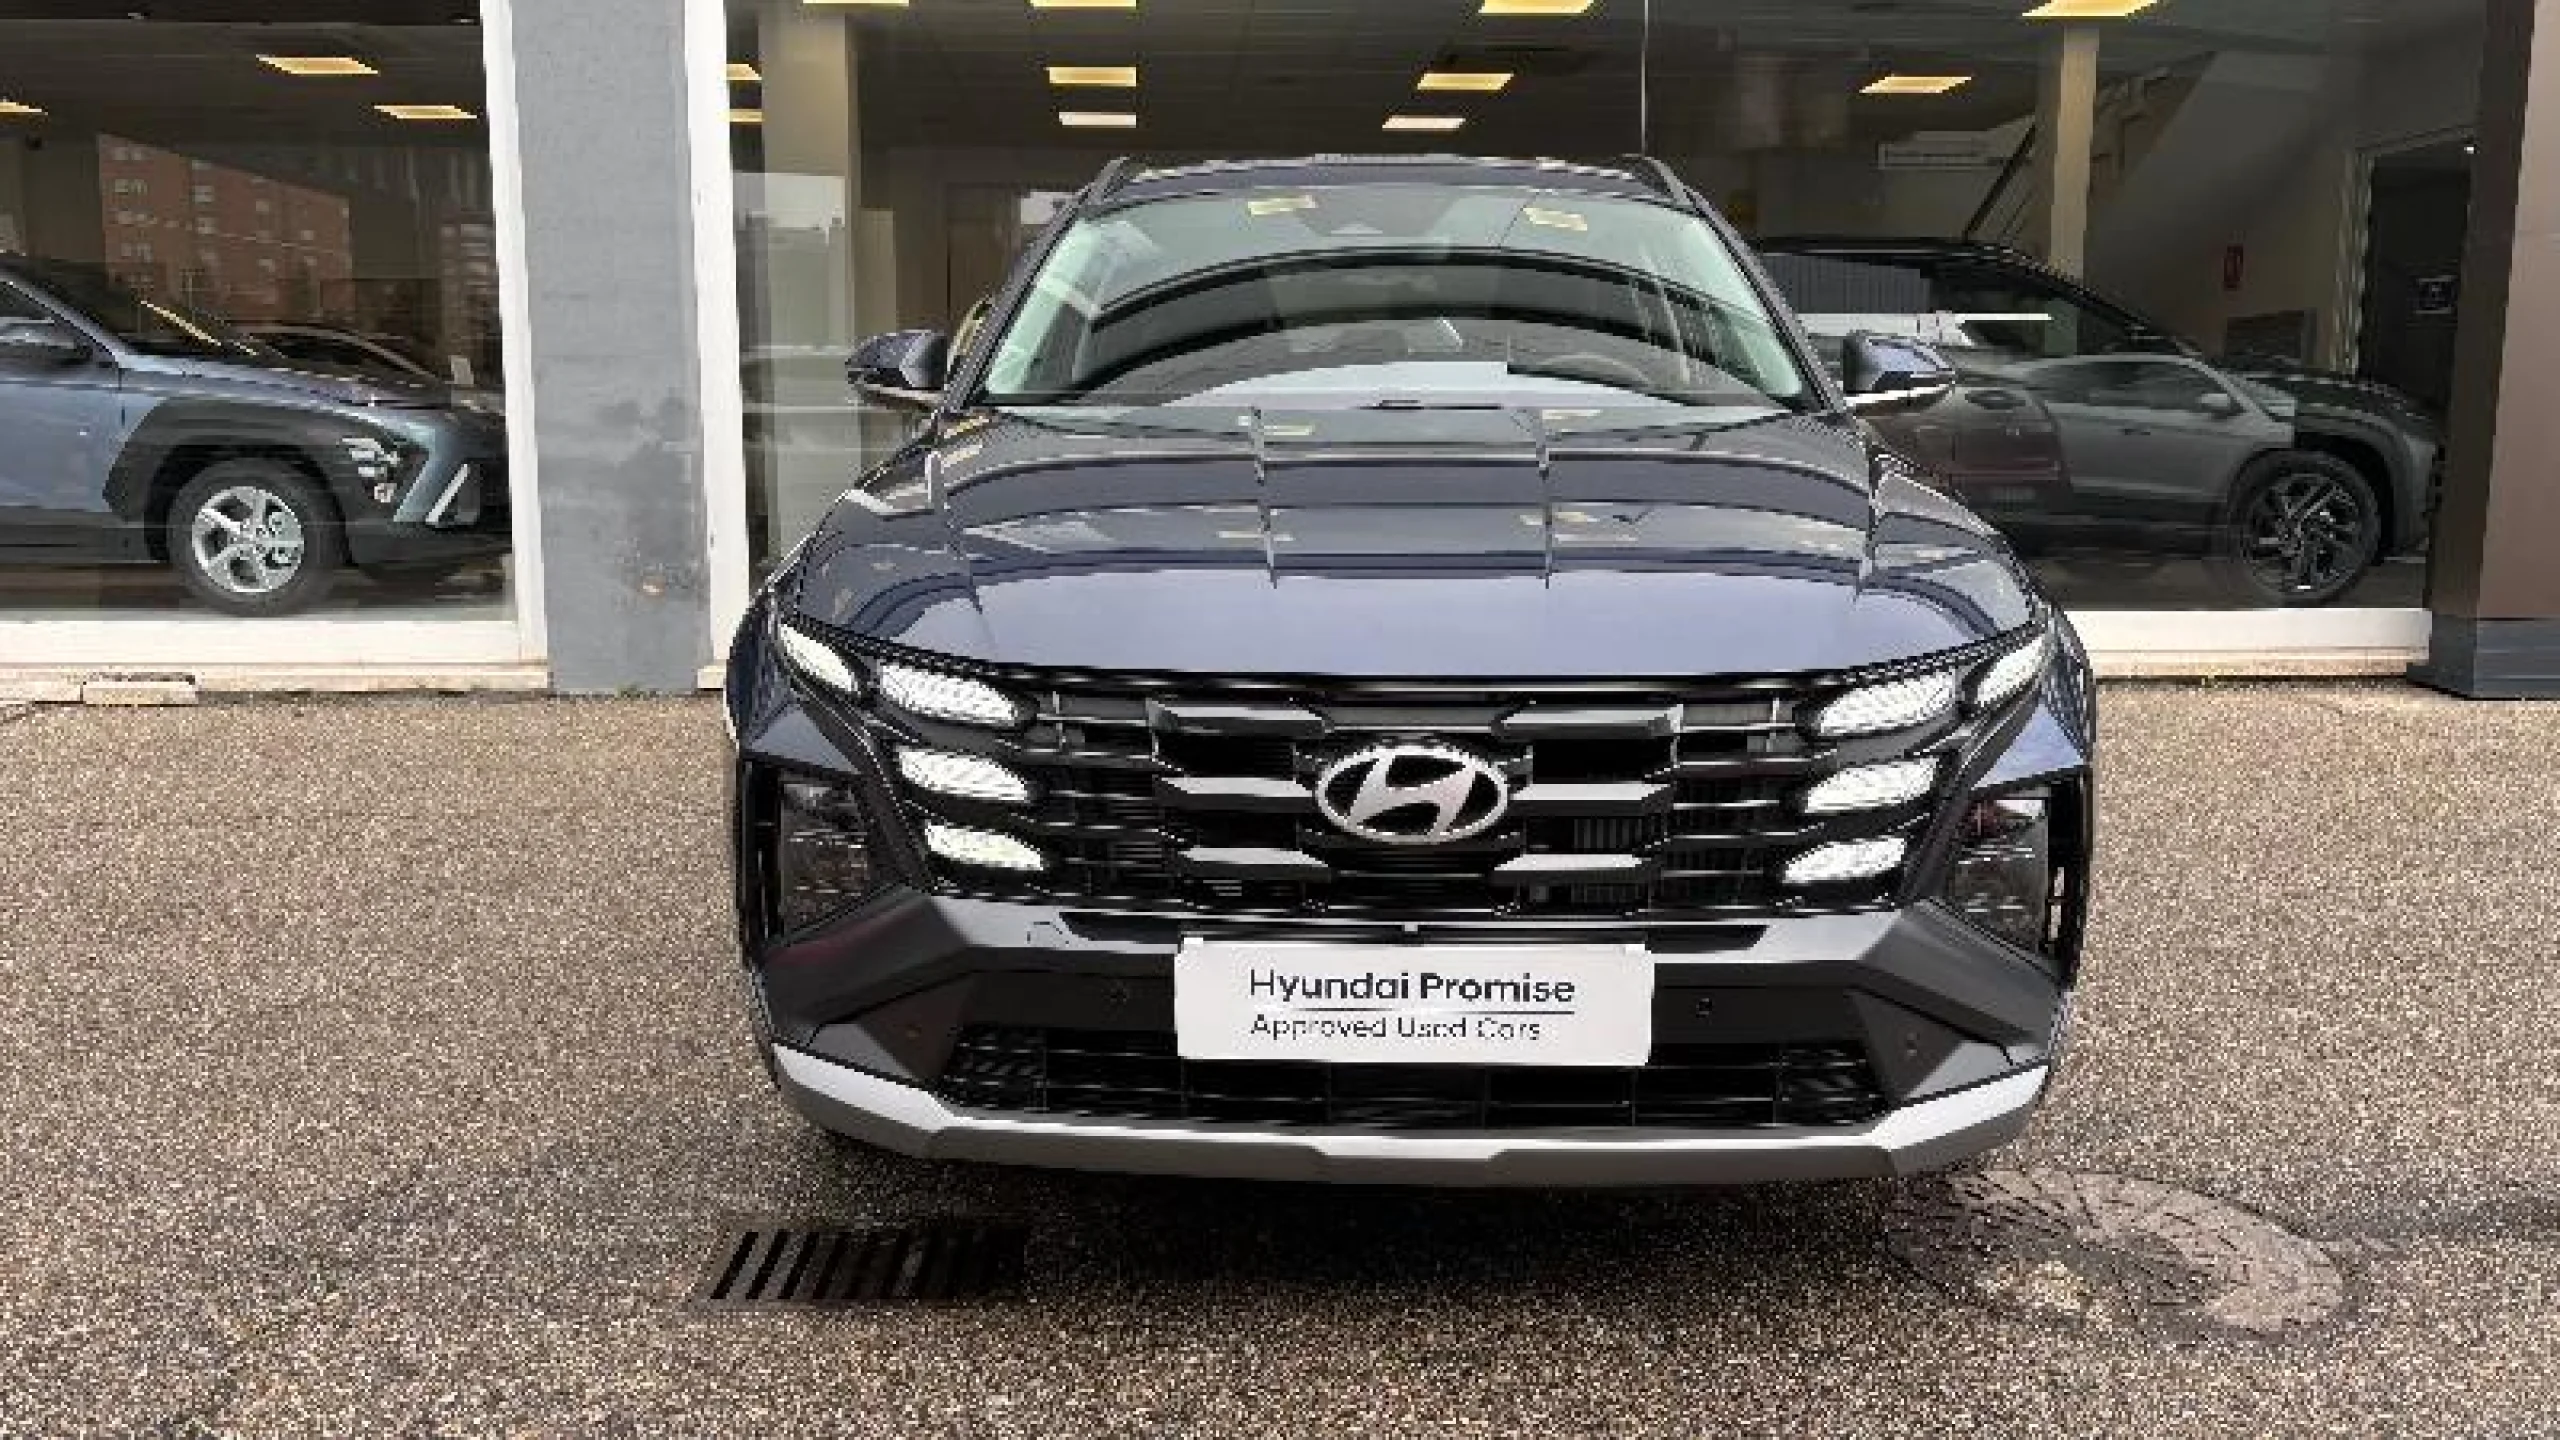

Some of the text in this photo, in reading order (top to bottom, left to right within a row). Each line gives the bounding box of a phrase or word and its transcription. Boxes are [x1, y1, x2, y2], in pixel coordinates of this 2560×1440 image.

[1250, 969, 1575, 1002] Hyundai Promise
[1251, 1013, 1541, 1040] Approved Used Cars
